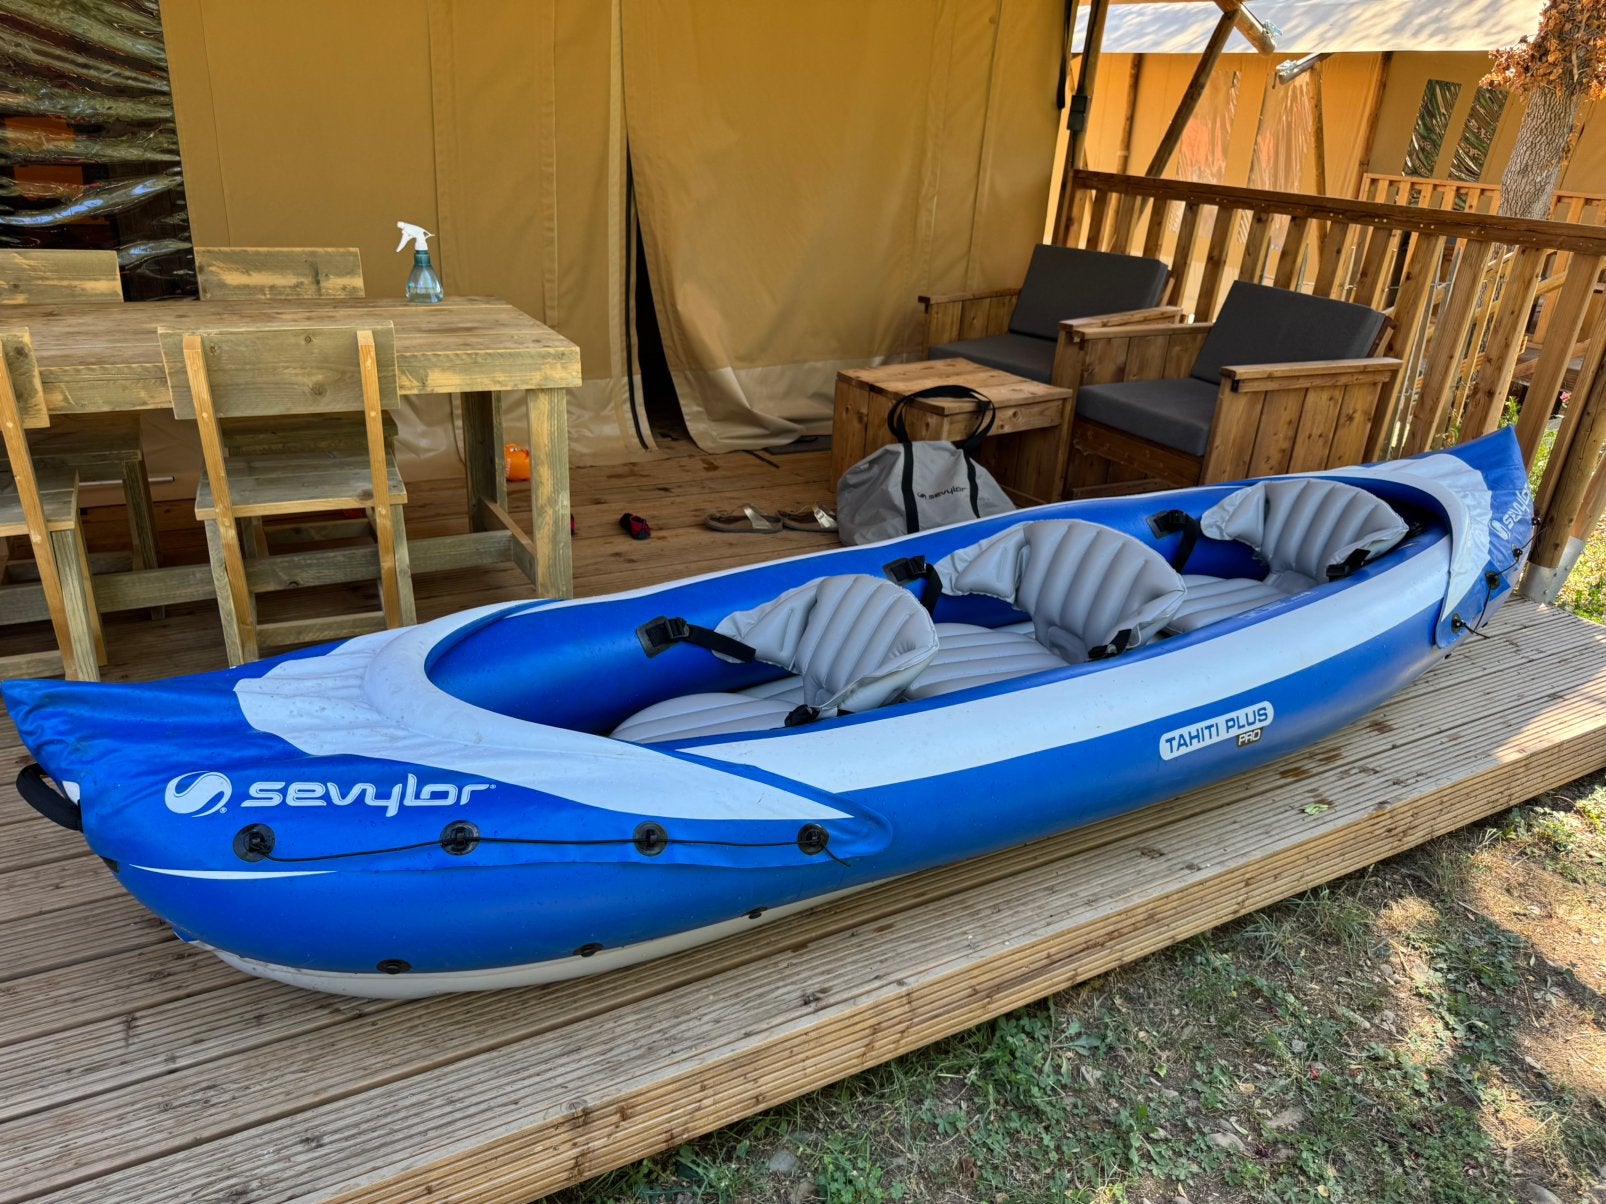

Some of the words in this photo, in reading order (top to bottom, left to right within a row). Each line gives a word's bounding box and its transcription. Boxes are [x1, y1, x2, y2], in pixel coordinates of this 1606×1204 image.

[928, 486, 967, 500] sevylor
[1165, 722, 1220, 754] TAHITI
[1225, 706, 1268, 733] PLUS
[1238, 729, 1261, 746] PRO
[240, 773, 490, 817] sevylor
